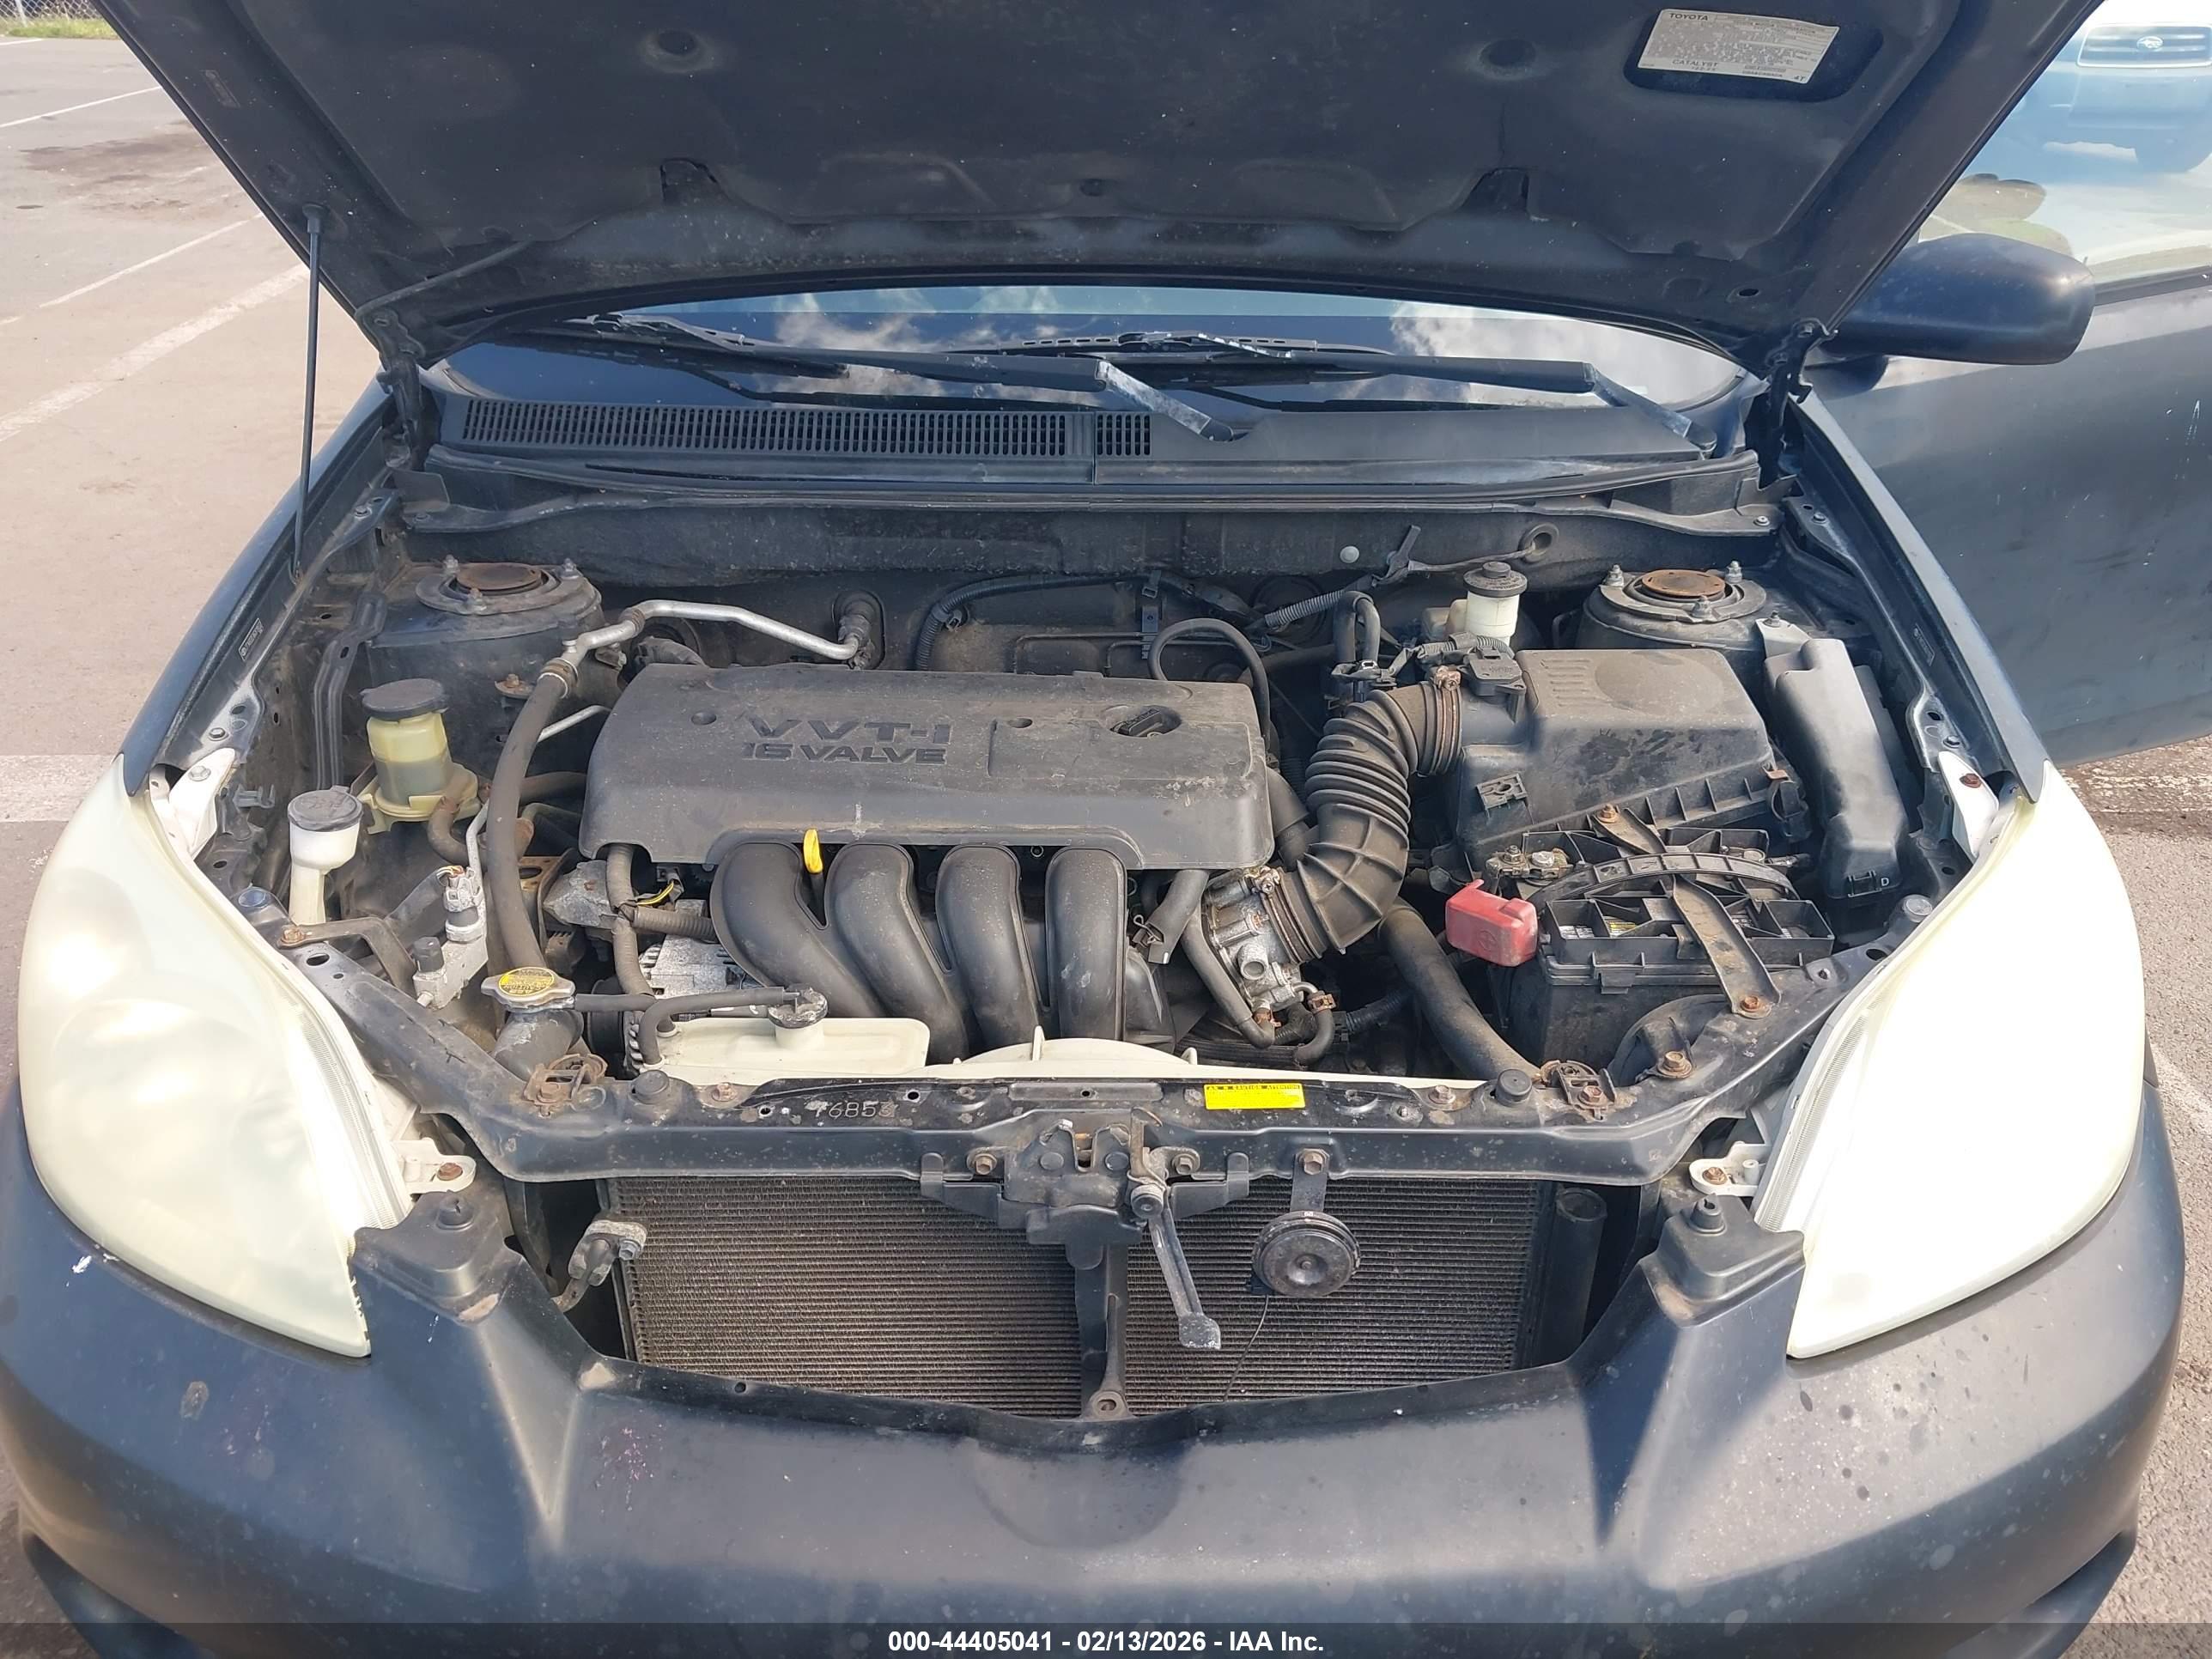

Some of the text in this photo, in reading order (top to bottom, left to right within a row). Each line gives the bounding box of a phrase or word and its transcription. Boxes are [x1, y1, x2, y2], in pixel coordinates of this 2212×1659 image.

[1669, 13, 1709, 21] TOYOTA
[743, 743, 946, 764] 16 VALVE
[1881, 878, 1889, 886] D
